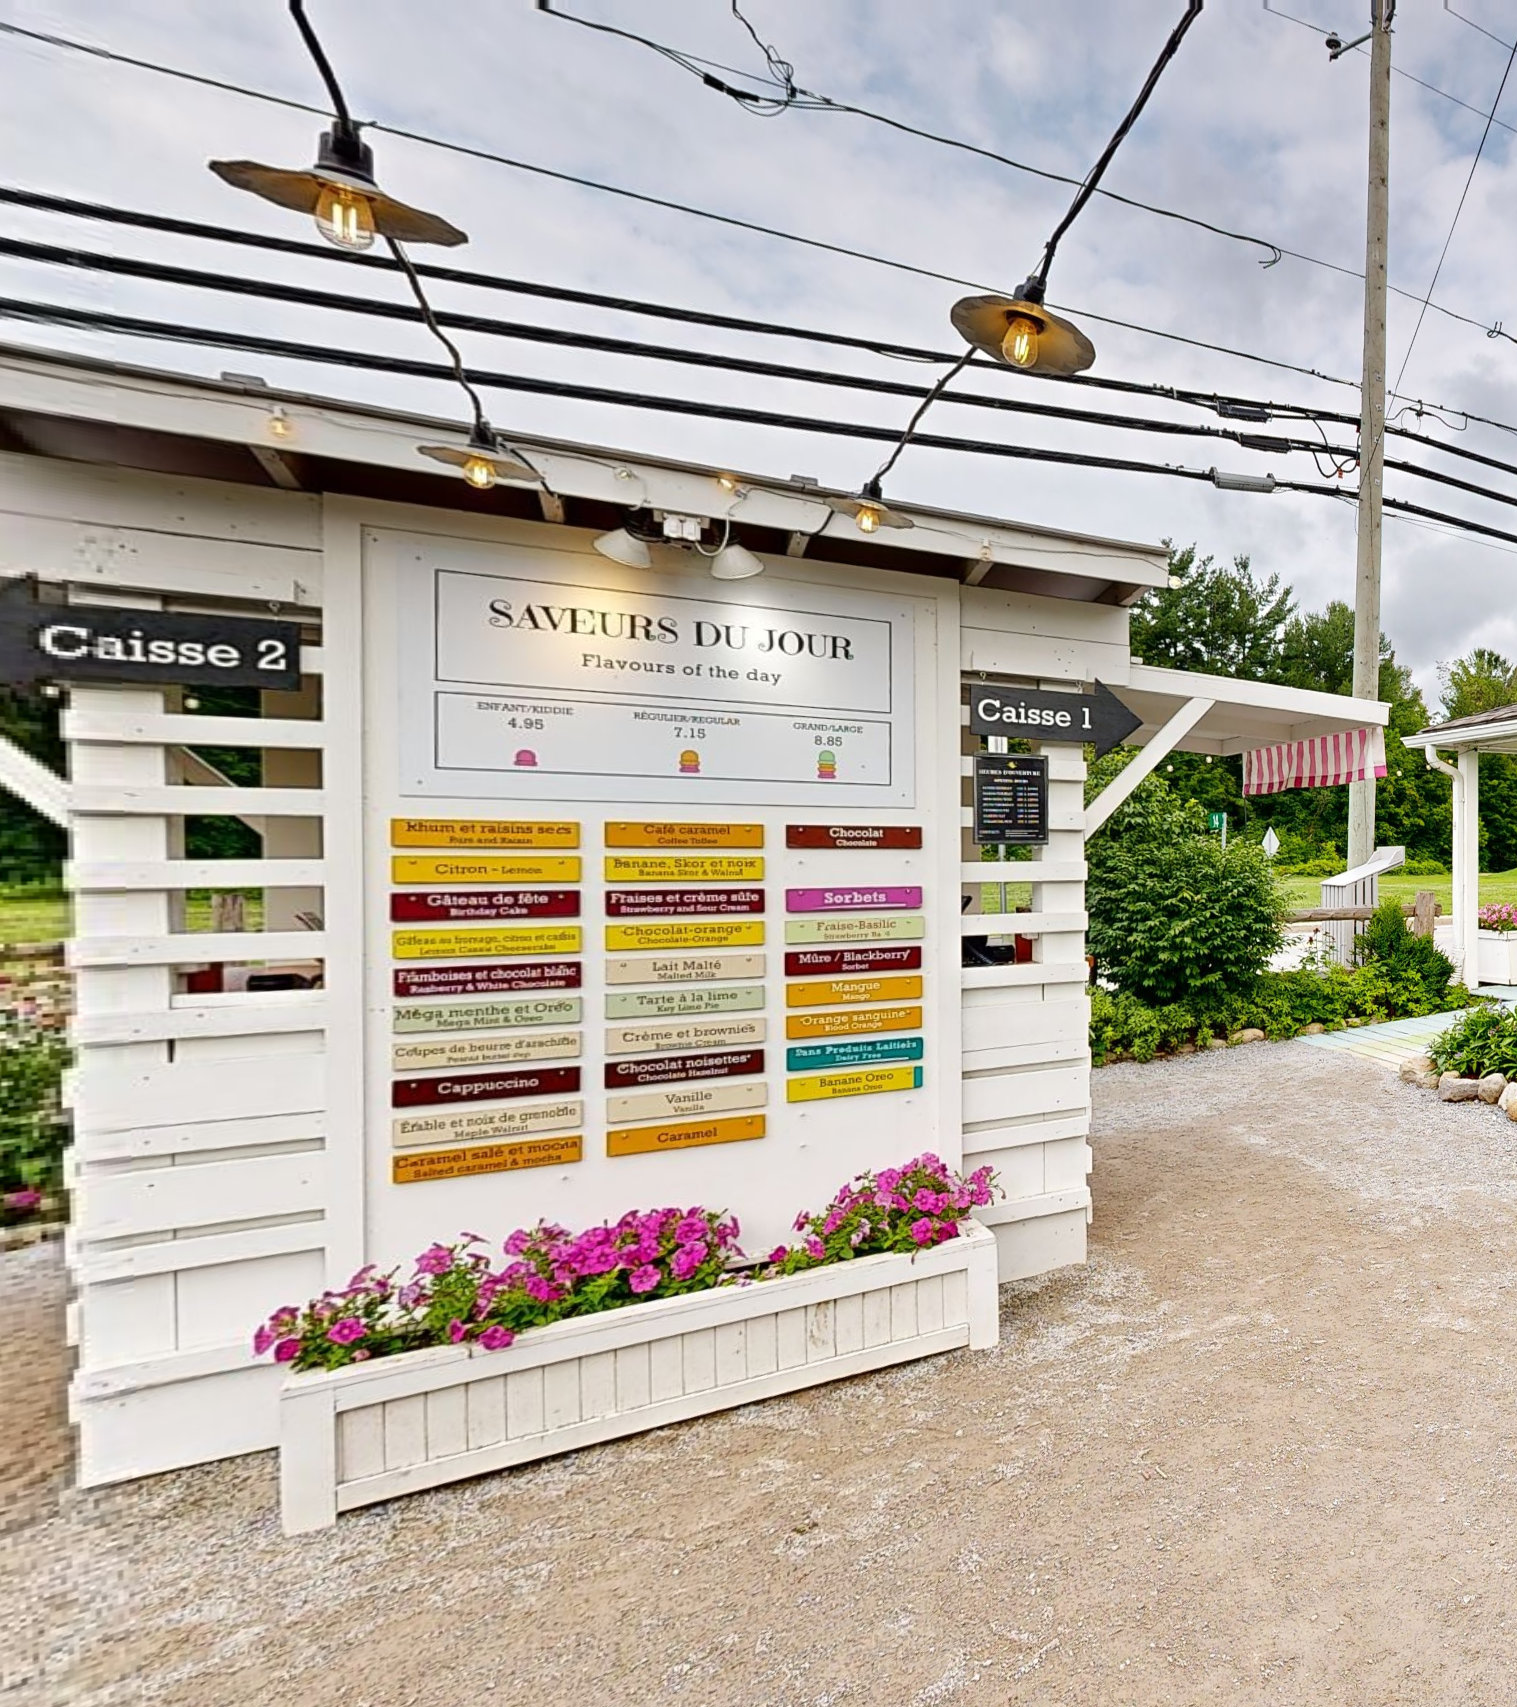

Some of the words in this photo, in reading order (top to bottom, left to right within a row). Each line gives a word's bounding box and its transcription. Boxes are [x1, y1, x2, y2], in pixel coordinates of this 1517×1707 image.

[489, 599, 678, 644] SAVEURS
[692, 621, 749, 649] DU
[758, 629, 854, 660] JOUR
[39, 625, 240, 668] Caisse
[257, 640, 286, 670] 2
[582, 653, 675, 674] Flavours
[683, 664, 703, 676] of
[709, 665, 739, 680] the
[746, 669, 782, 686] day
[477, 702, 574, 715] ENFANT/KIDDIE
[978, 699, 1071, 727] Caisse
[1082, 708, 1092, 729] 1
[508, 718, 544, 729] 4.95
[793, 722, 863, 734] GRAND/LARGE
[674, 727, 706, 739] 7.15
[815, 735, 842, 747] 8.85
[406, 822, 455, 833] Rhum
[460, 823, 475, 833] et
[481, 823, 532, 834] raisins
[537, 826, 572, 834] secs
[644, 824, 675, 834] Café
[679, 825, 731, 835] caramel
[829, 828, 883, 838] Chocolat
[435, 863, 487, 875] Citron
[501, 866, 543, 874] Lemon
[674, 859, 706, 868] Skor
[710, 860, 723, 868] et
[727, 860, 756, 868] noix
[427, 894, 488, 907] Gâteau
[493, 894, 514, 905] de
[518, 893, 549, 904] fête
[610, 893, 663, 904] Fraises
[666, 893, 680, 903] et
[824, 892, 886, 904] Sorbets
[450, 908, 497, 917] Birthday
[500, 906, 528, 915] Cake
[620, 905, 675, 914] Strawberry
[677, 904, 694, 912] and
[719, 904, 750, 912] Cream
[623, 926, 742, 936] Chocolat-orange
[816, 920, 896, 931] Fraise-Basilic
[799, 954, 831, 964] Mûre
[843, 949, 911, 962] Blackberry
[652, 961, 678, 971] Lait
[683, 960, 721, 971] Malté
[398, 971, 472, 983] Framboises
[475, 970, 487, 980] et
[490, 967, 541, 979] chocolat
[657, 972, 692, 980] Malted
[694, 971, 716, 979] Milk
[832, 982, 880, 993] Mangue
[636, 995, 675, 1005] Tarte
[691, 993, 703, 1002] la
[708, 991, 738, 1000] lime
[395, 1008, 443, 1022] Méga
[448, 1005, 510, 1018] menthe
[514, 1004, 529, 1014] et
[801, 1015, 848, 1025] Orange
[852, 1010, 906, 1023] sanguine
[677, 1029, 690, 1038] et
[694, 1024, 756, 1037] brownies
[450, 1044, 465, 1054] de
[469, 1041, 511, 1052] beurre
[825, 1044, 872, 1055] Produits
[617, 1058, 684, 1074] Chocolat
[686, 1054, 747, 1068] noisettes
[835, 1054, 858, 1062] Dairy
[637, 1072, 686, 1082] Chocolate
[819, 1077, 862, 1088] Banane
[866, 1073, 894, 1082] Oreo
[438, 1077, 539, 1095] Cappuccino
[832, 1086, 862, 1094] Banana
[665, 1091, 712, 1104] Vanille
[673, 1104, 705, 1113] Vanilla
[450, 1118, 463, 1128] et
[466, 1114, 496, 1126] noix
[498, 1113, 515, 1123] de
[657, 1127, 717, 1143] Caramel
[395, 1151, 467, 1169] Caramel
[471, 1146, 504, 1160] salé
[508, 1146, 523, 1156] et
